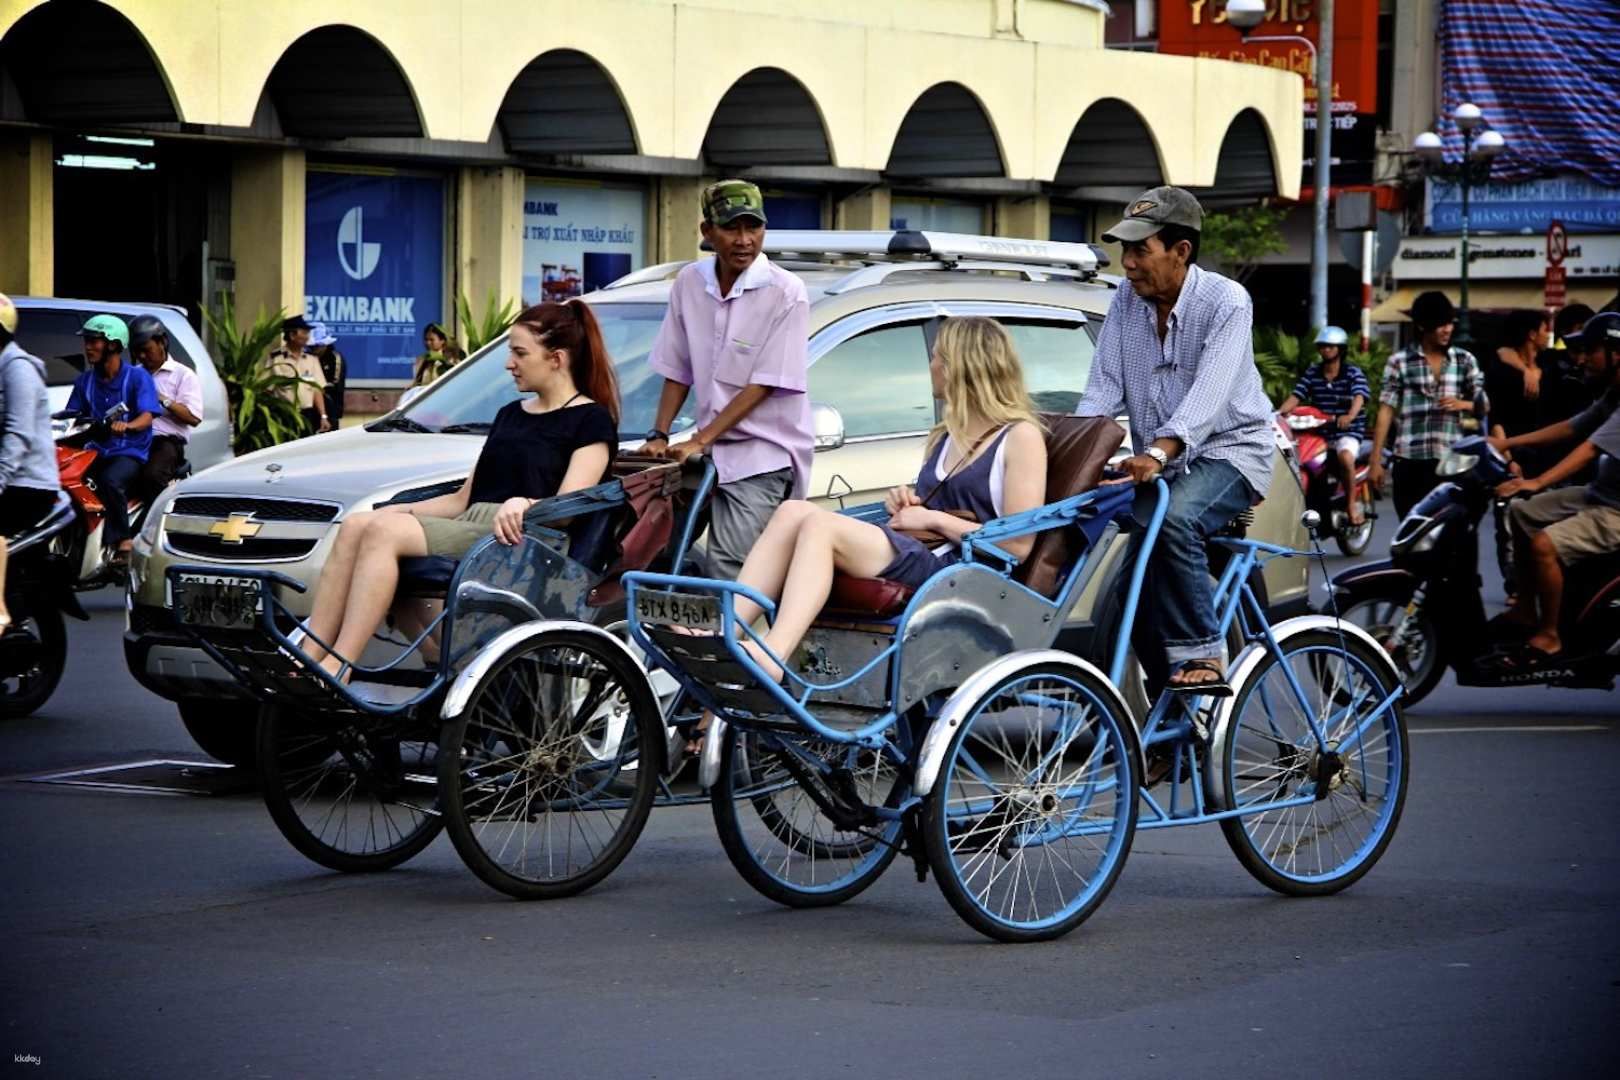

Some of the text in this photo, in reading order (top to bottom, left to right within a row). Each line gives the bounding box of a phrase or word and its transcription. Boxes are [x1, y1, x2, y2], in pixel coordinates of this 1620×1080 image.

[1401, 246, 1456, 260] diamond
[1468, 247, 1536, 264] gemstones
[303, 295, 416, 323] EXIMBANK
[1501, 668, 1575, 682] HONDA
